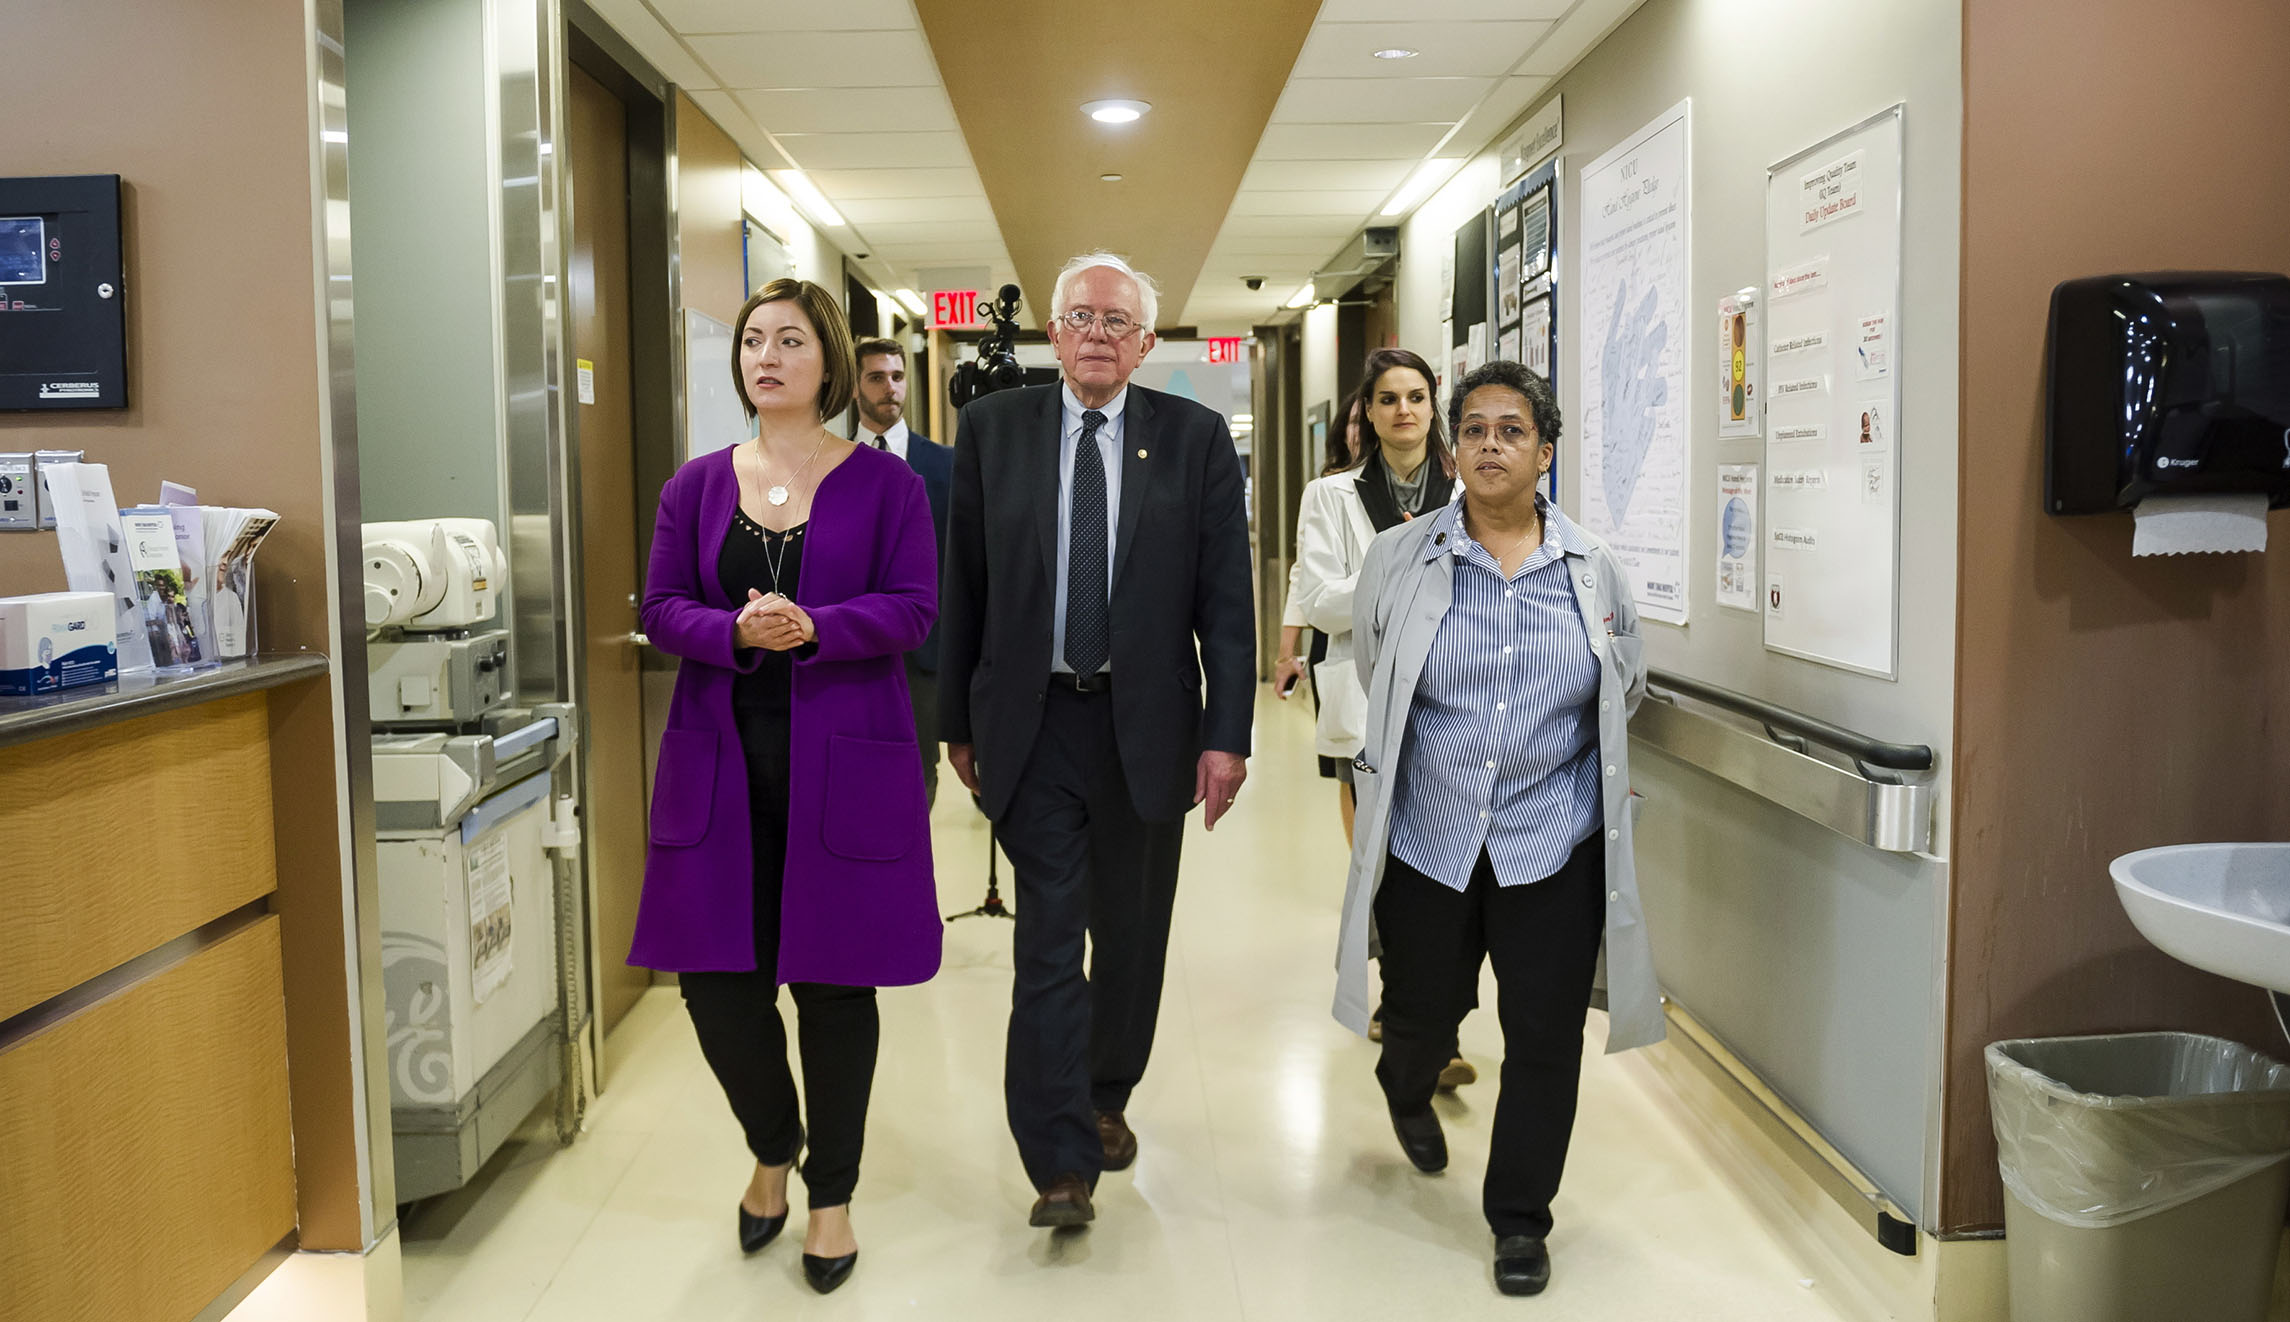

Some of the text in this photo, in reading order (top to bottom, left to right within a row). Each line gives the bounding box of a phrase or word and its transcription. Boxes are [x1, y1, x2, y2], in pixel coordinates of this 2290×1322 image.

[1620, 158, 1638, 181] NICU
[1804, 161, 1857, 191] Improving Quality Team
[1805, 192, 1857, 224] Daily Update Board
[934, 291, 977, 325] EXIT
[1208, 337, 1242, 363] EXIT
[1735, 360, 1743, 373] 92
[2170, 459, 2199, 468] Kruger
